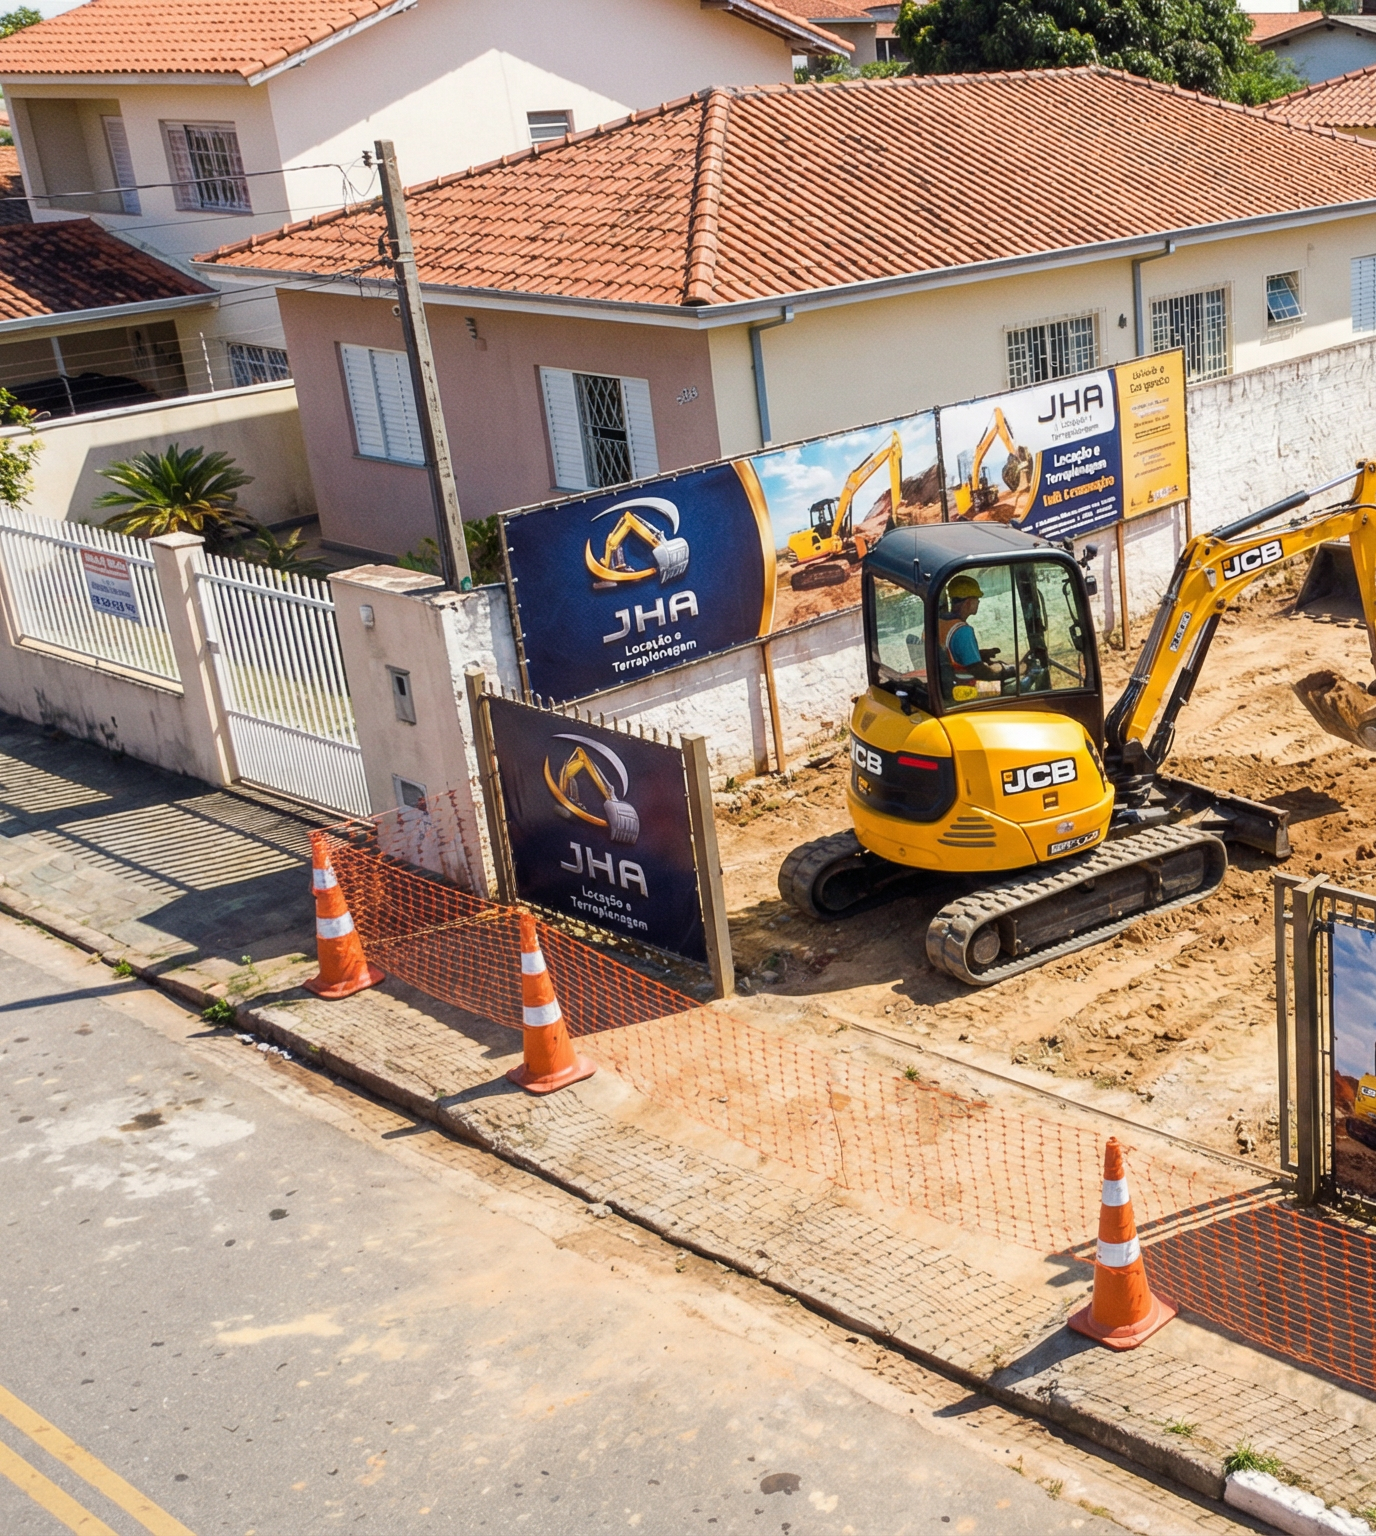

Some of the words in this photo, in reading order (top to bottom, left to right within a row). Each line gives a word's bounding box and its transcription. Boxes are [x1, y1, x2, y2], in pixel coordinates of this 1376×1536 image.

[1038, 384, 1103, 423] JHA
[1224, 541, 1283, 579] JCB
[603, 590, 699, 643] JHA
[1004, 758, 1076, 793] JCB
[560, 841, 649, 898] JHA
